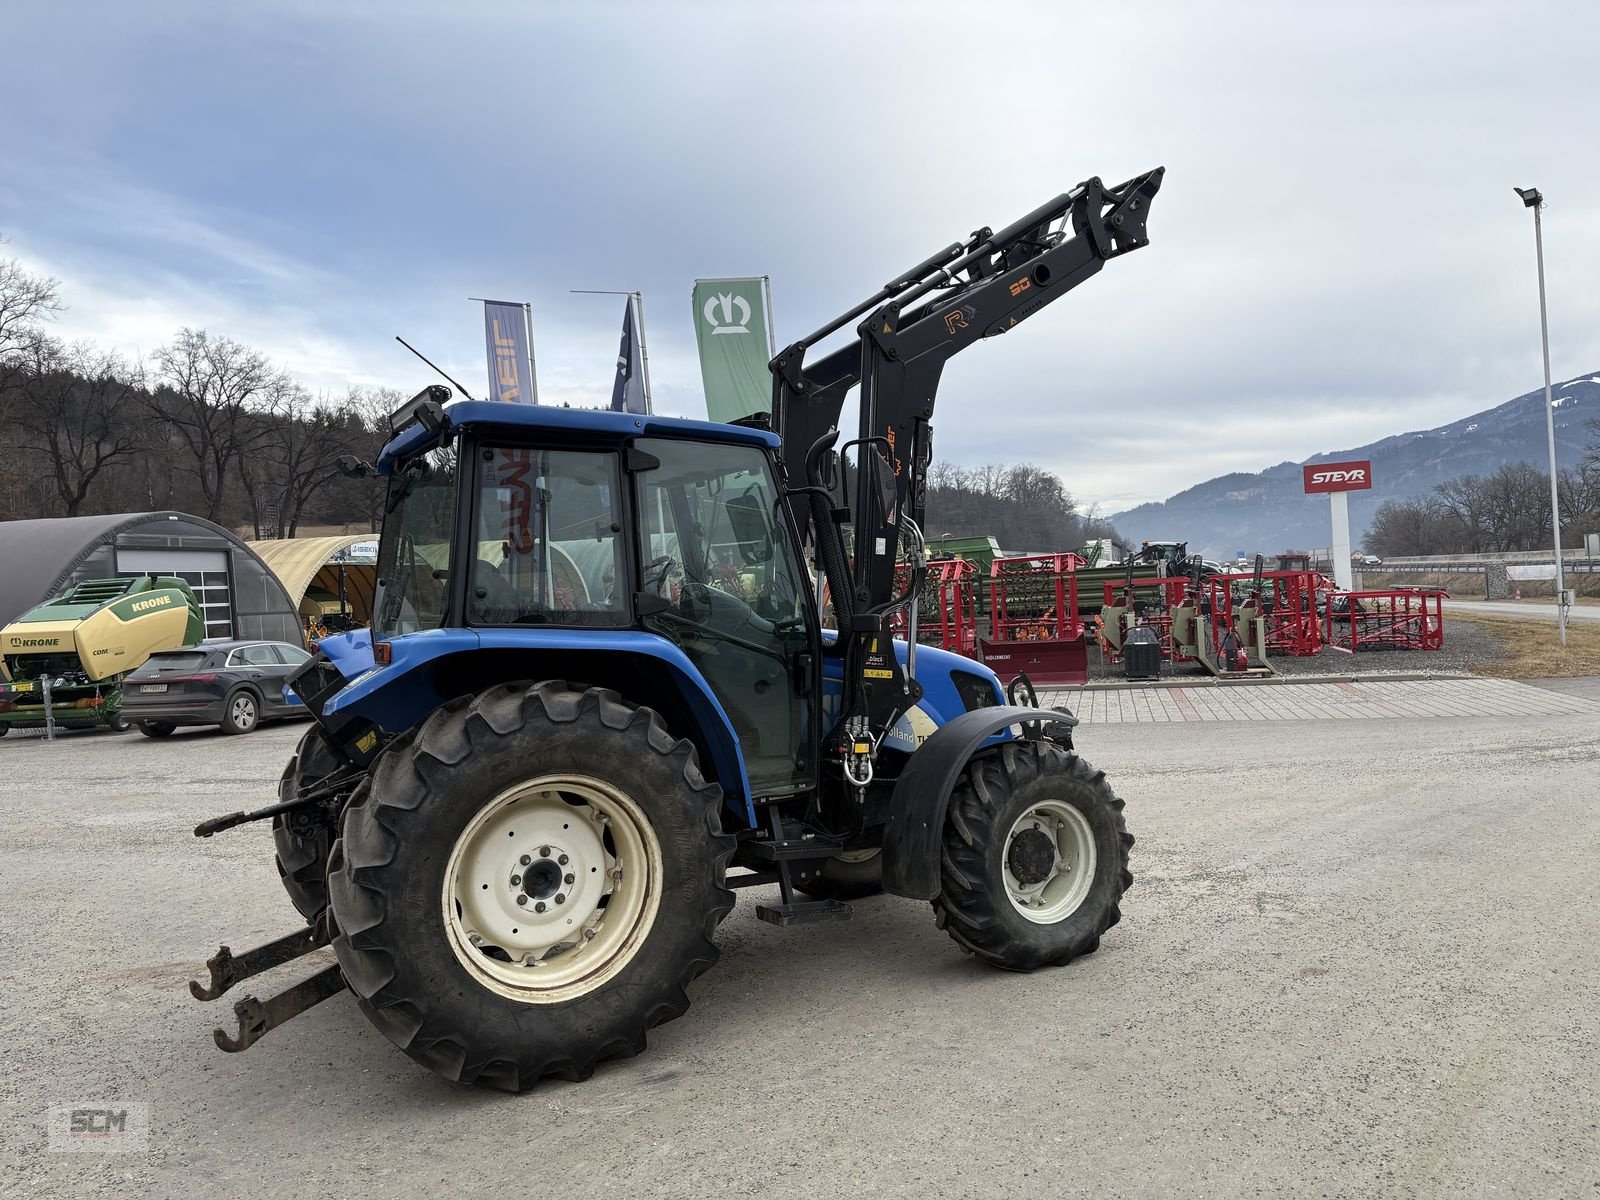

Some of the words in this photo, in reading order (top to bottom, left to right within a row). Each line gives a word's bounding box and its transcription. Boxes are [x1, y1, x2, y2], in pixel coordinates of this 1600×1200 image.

[1311, 469, 1366, 484] STEYR
[131, 595, 172, 612] KRONE
[22, 638, 60, 647] KRONE
[888, 726, 914, 744] olland
